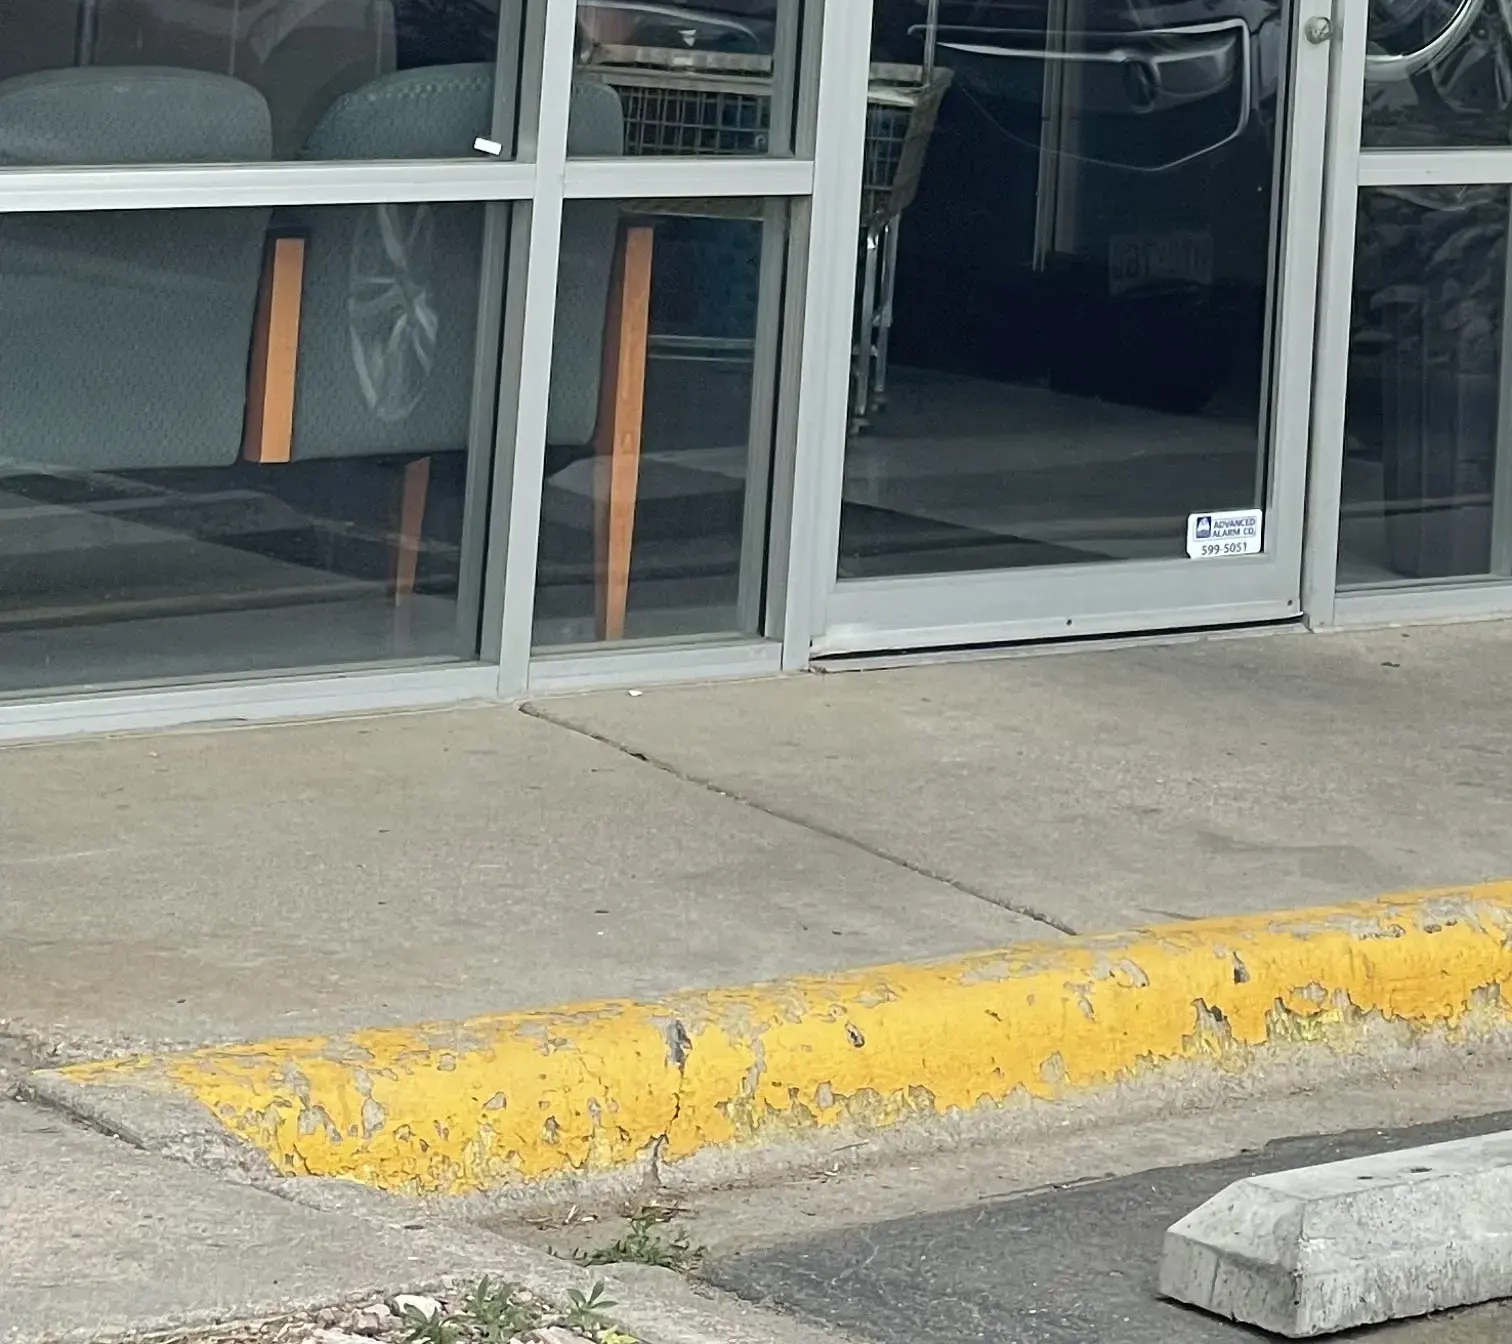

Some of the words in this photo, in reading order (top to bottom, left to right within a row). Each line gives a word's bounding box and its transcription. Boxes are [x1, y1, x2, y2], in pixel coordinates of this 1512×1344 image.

[1213, 518, 1255, 529] ADVANCED
[1212, 528, 1240, 538] ALARM
[1201, 541, 1247, 555] 599-5051
